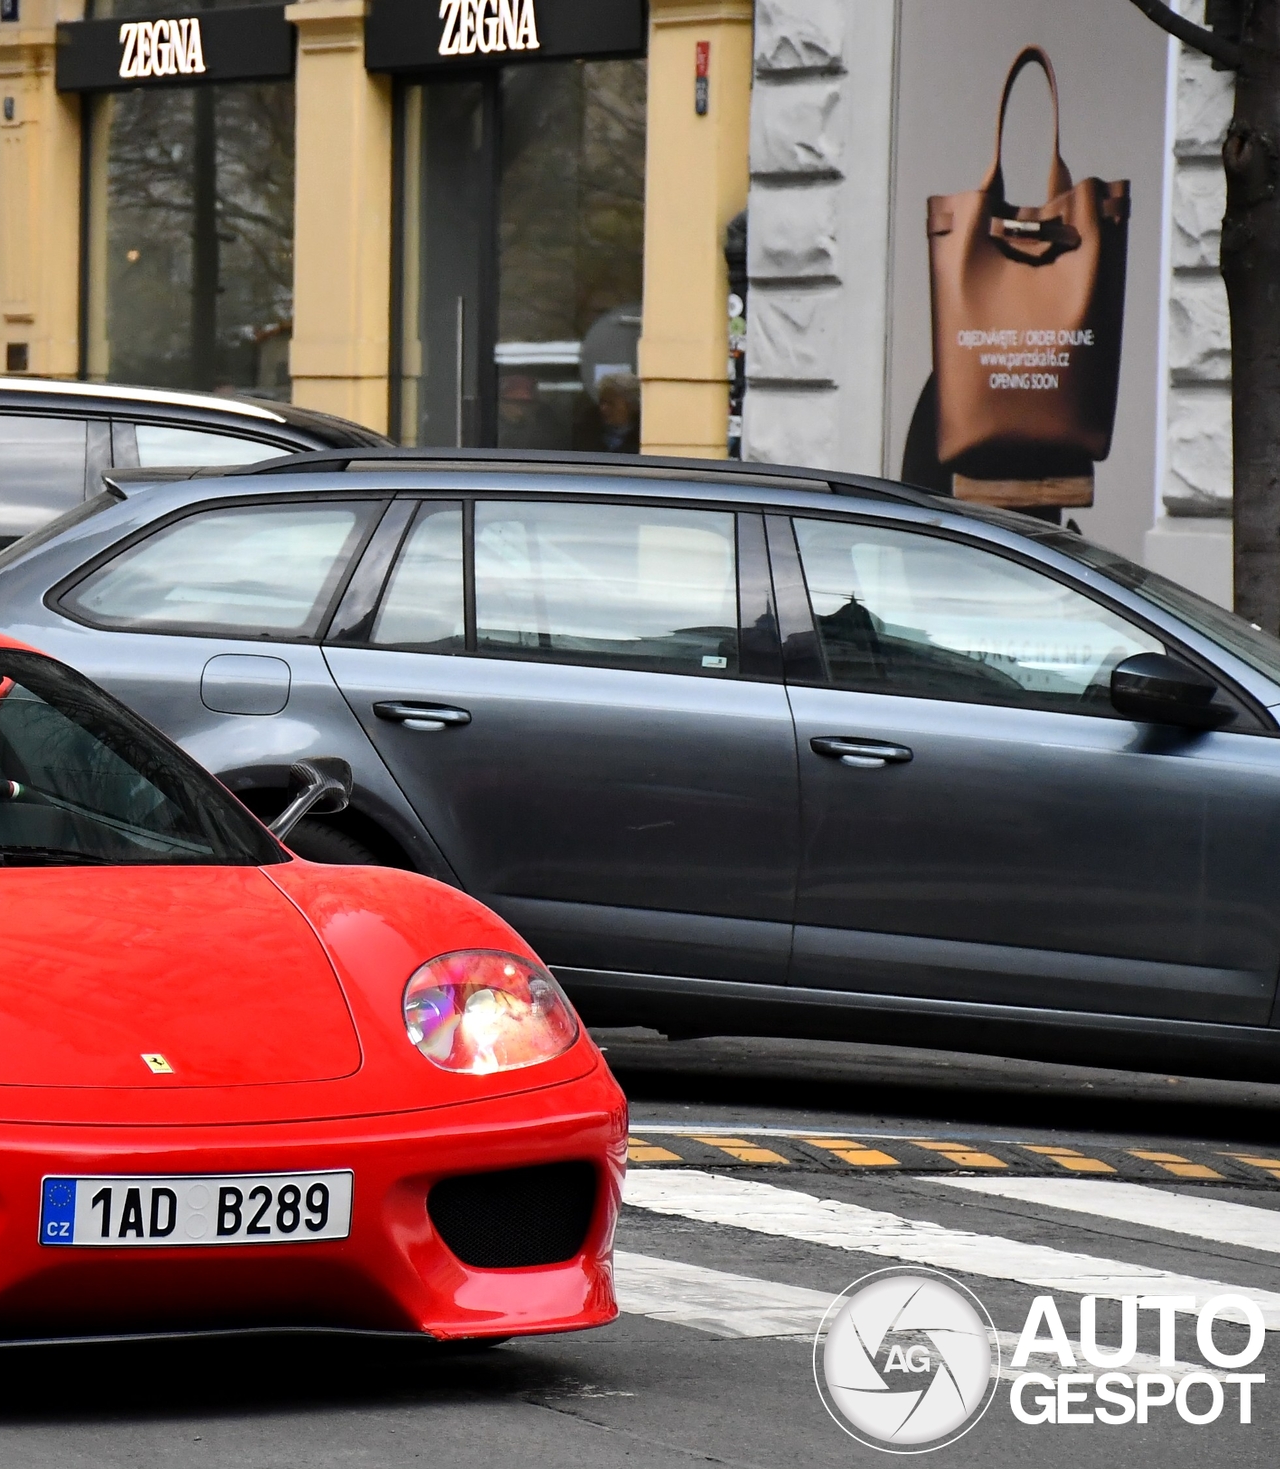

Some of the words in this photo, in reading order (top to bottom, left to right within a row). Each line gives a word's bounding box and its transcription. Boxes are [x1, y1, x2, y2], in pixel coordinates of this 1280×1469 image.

[438, 0, 540, 55] ZEGNA
[120, 18, 206, 78] ZEGNA
[1026, 329, 1056, 346] ORDER
[989, 372, 1030, 389] OPENING
[1031, 372, 1059, 389] SOON
[91, 1186, 178, 1238] 1AD
[216, 1182, 330, 1236] B289
[47, 1222, 70, 1237] CZ
